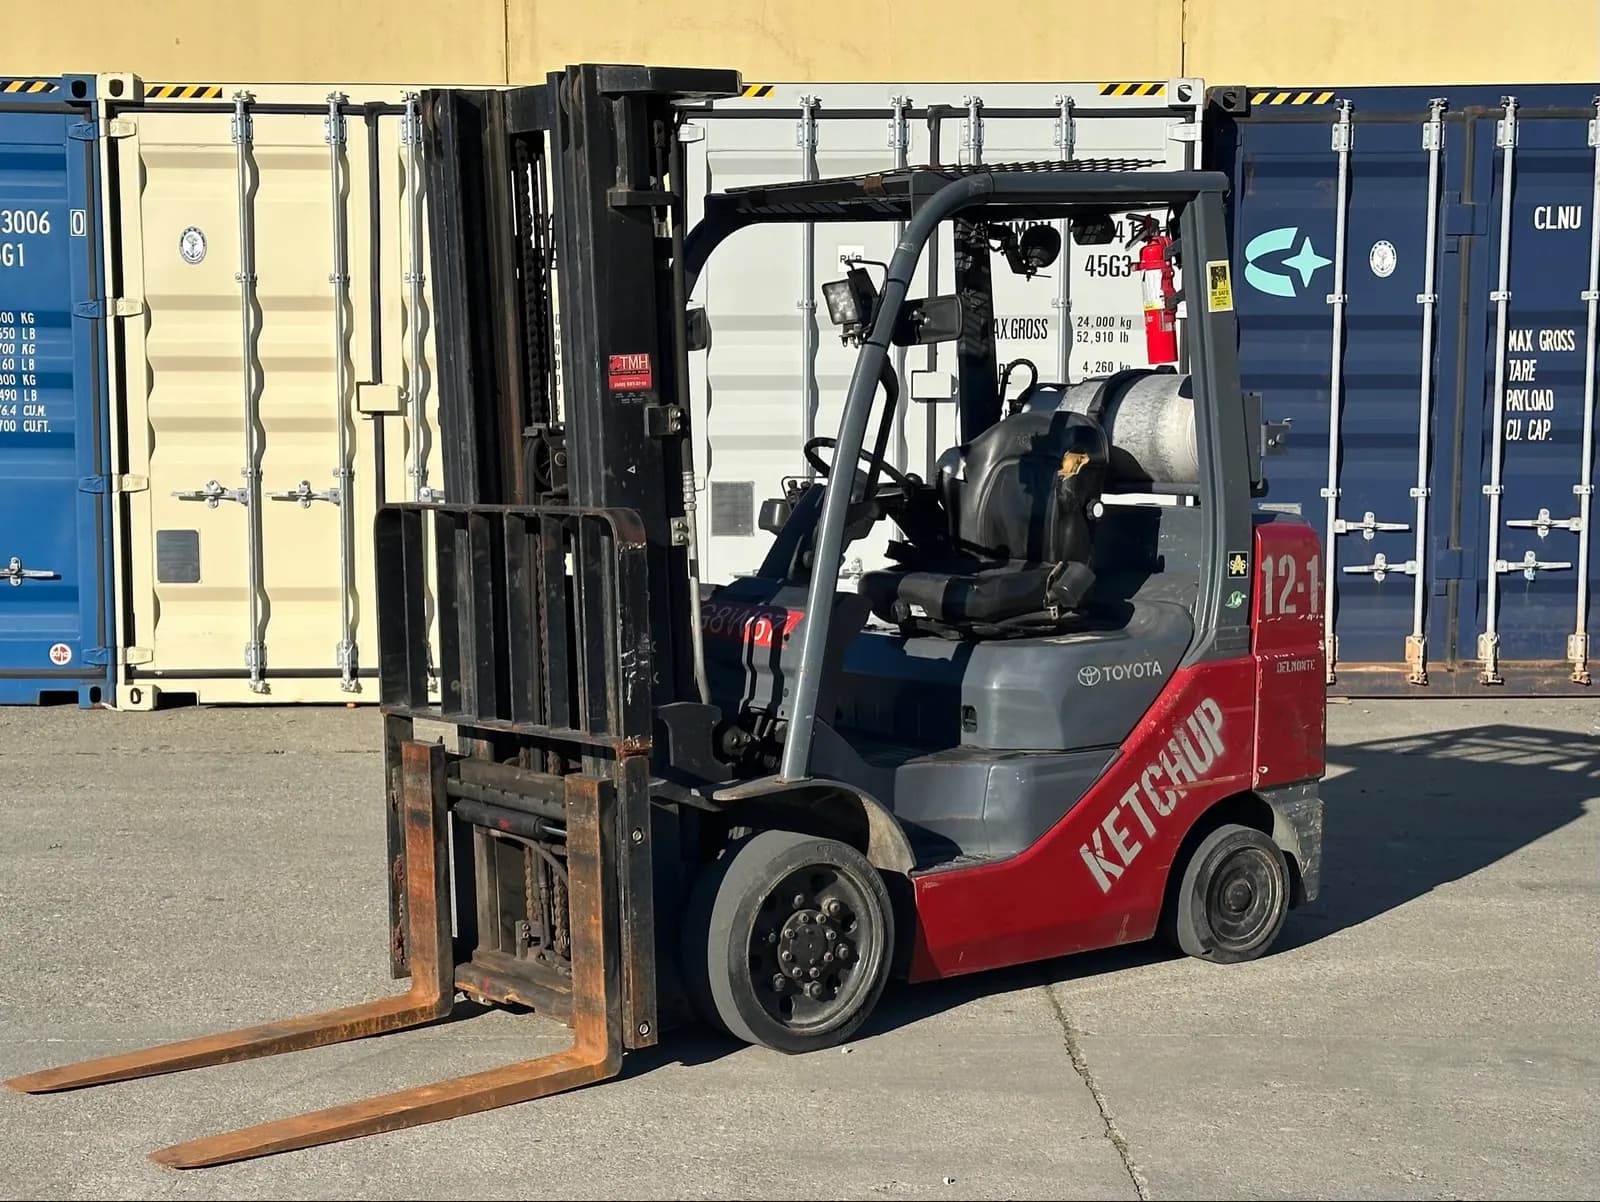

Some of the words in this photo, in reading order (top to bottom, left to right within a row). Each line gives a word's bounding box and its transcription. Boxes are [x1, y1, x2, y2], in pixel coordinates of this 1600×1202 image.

[1, 210, 50, 234] 3006
[1534, 206, 1582, 230] CLNU
[0, 243, 24, 267] G1
[1085, 255, 1132, 277] 45G3
[0, 312, 14, 324] 00
[21, 312, 35, 324] KG
[1077, 316, 1114, 328] 24,000
[1120, 316, 1132, 330] kg
[22, 327, 36, 340] LB
[993, 318, 1048, 340] AX.GROSS
[1076, 331, 1114, 344] 52,910
[21, 343, 36, 355] KG
[1508, 330, 1534, 351] MAX
[1539, 330, 1575, 351] GROSS
[21, 358, 35, 371] LB
[620, 354, 649, 371] TMH
[1082, 360, 1114, 374] 4,260
[1509, 360, 1537, 382] TARE
[22, 374, 36, 386] KG
[23, 389, 37, 402] LB
[1506, 389, 1554, 411] PAYLOAD
[0, 404, 17, 416] 6.4
[1506, 419, 1523, 441] CU.
[1527, 419, 1553, 441] CAP.
[1103, 660, 1163, 682] TOYOTA
[1078, 697, 1226, 894] KETCHUP
